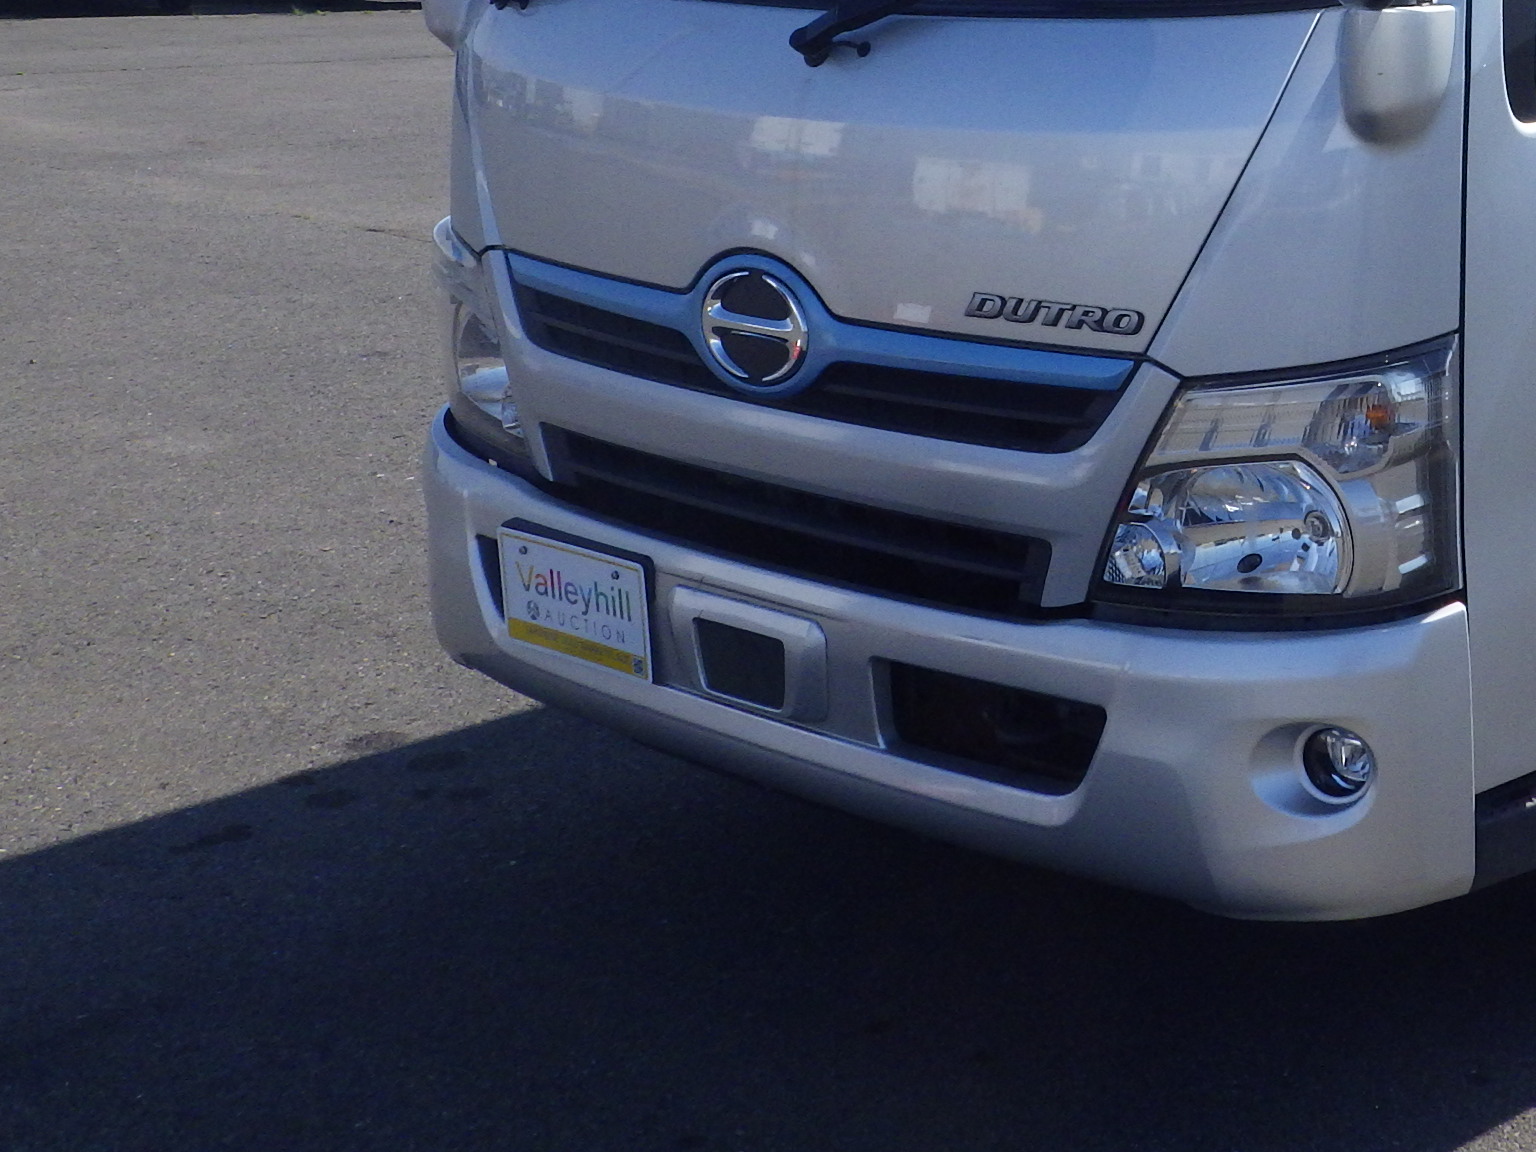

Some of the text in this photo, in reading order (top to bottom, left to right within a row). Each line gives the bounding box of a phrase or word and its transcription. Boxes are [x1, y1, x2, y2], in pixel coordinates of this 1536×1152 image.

[965, 291, 1145, 336] DUTRO
[515, 560, 632, 622] Valleyhill
[545, 610, 625, 644] AUCTION
